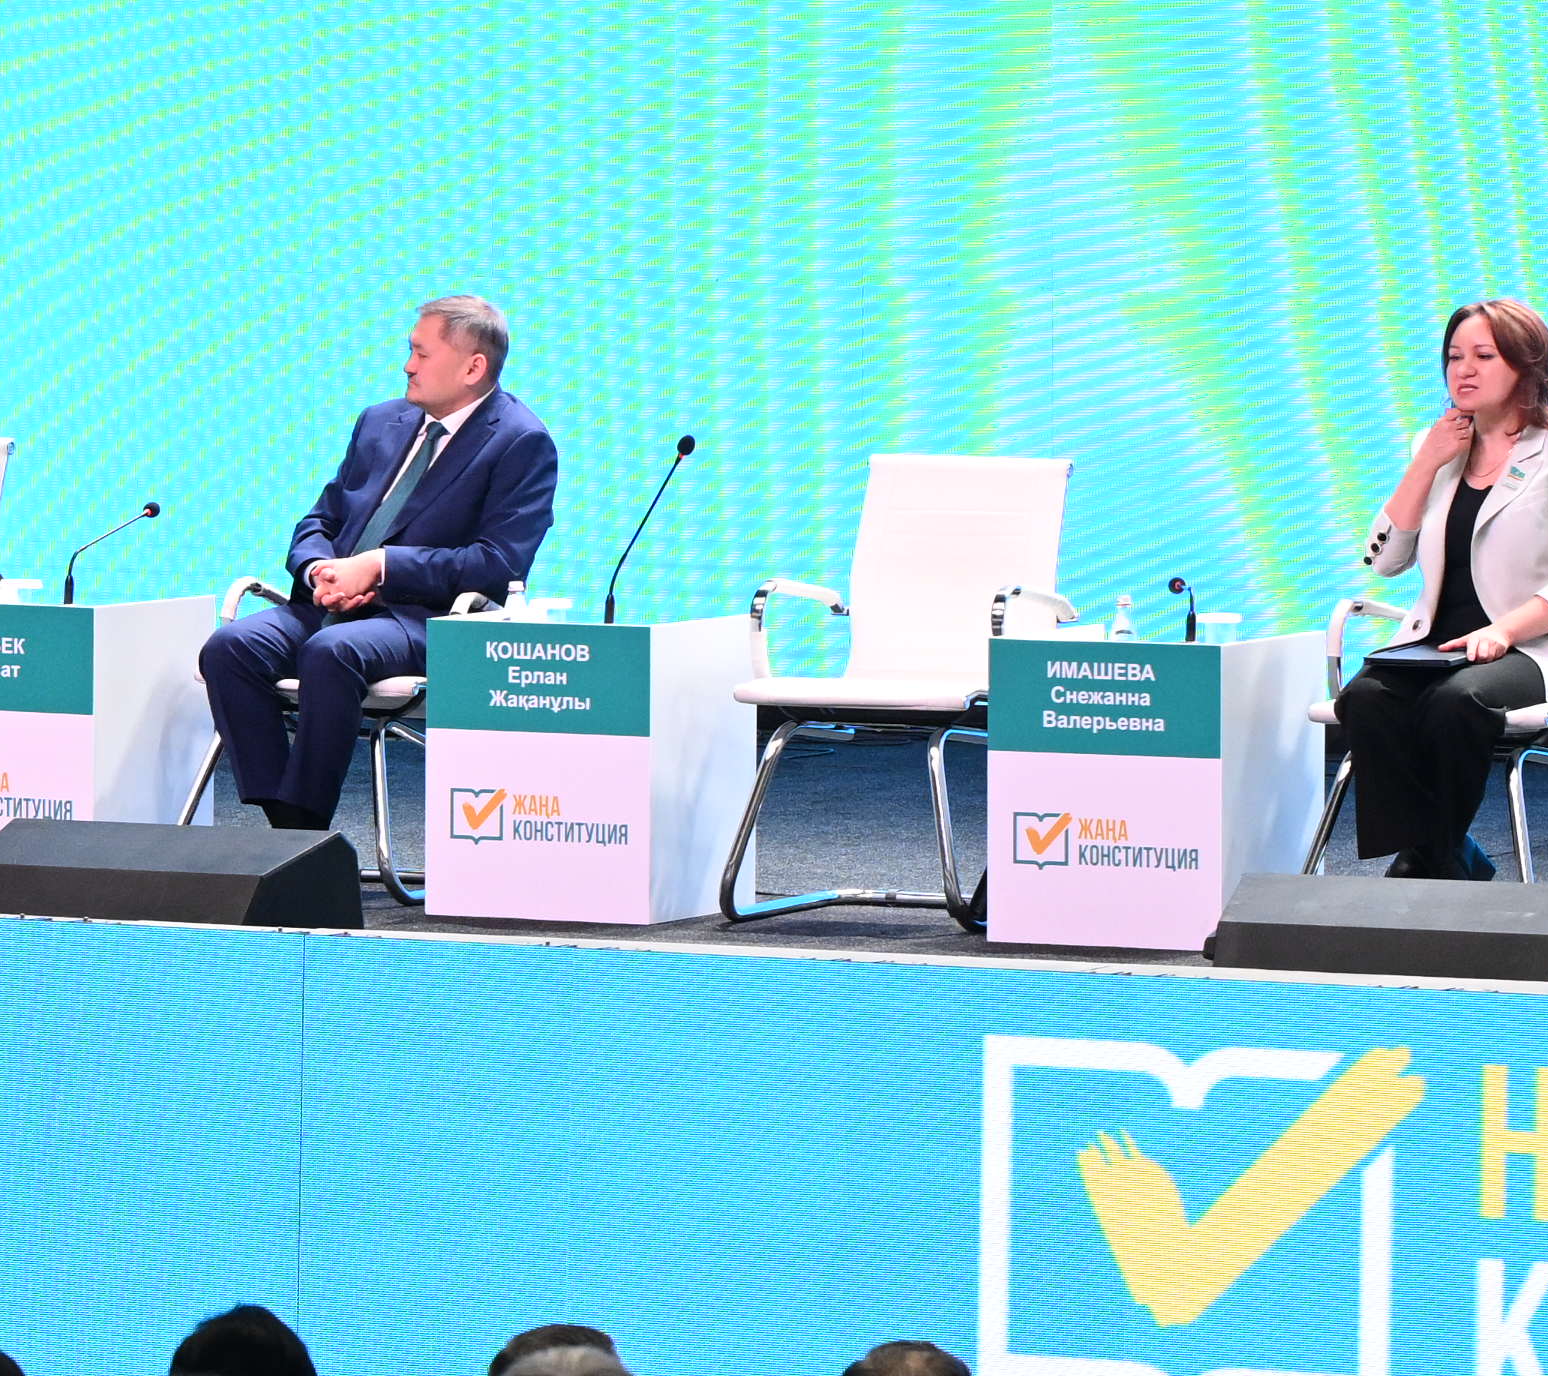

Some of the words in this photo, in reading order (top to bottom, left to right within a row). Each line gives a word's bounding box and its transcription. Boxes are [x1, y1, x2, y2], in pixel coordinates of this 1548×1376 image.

[485, 641, 590, 662] ҚОШАНОВ
[508, 666, 567, 687] Ерлан
[1047, 661, 1155, 681] ИМАШЕВА
[489, 689, 591, 712] Жақанұлы
[1050, 686, 1151, 706] Снежанна
[1042, 710, 1165, 733] Валерьевна
[512, 794, 561, 818] ЖАҢА
[512, 819, 628, 846] КОНСТИТУЦИЯ
[1078, 818, 1128, 843] ЖАҢА
[1078, 844, 1199, 872] КОНСТИТУЦИЯ
